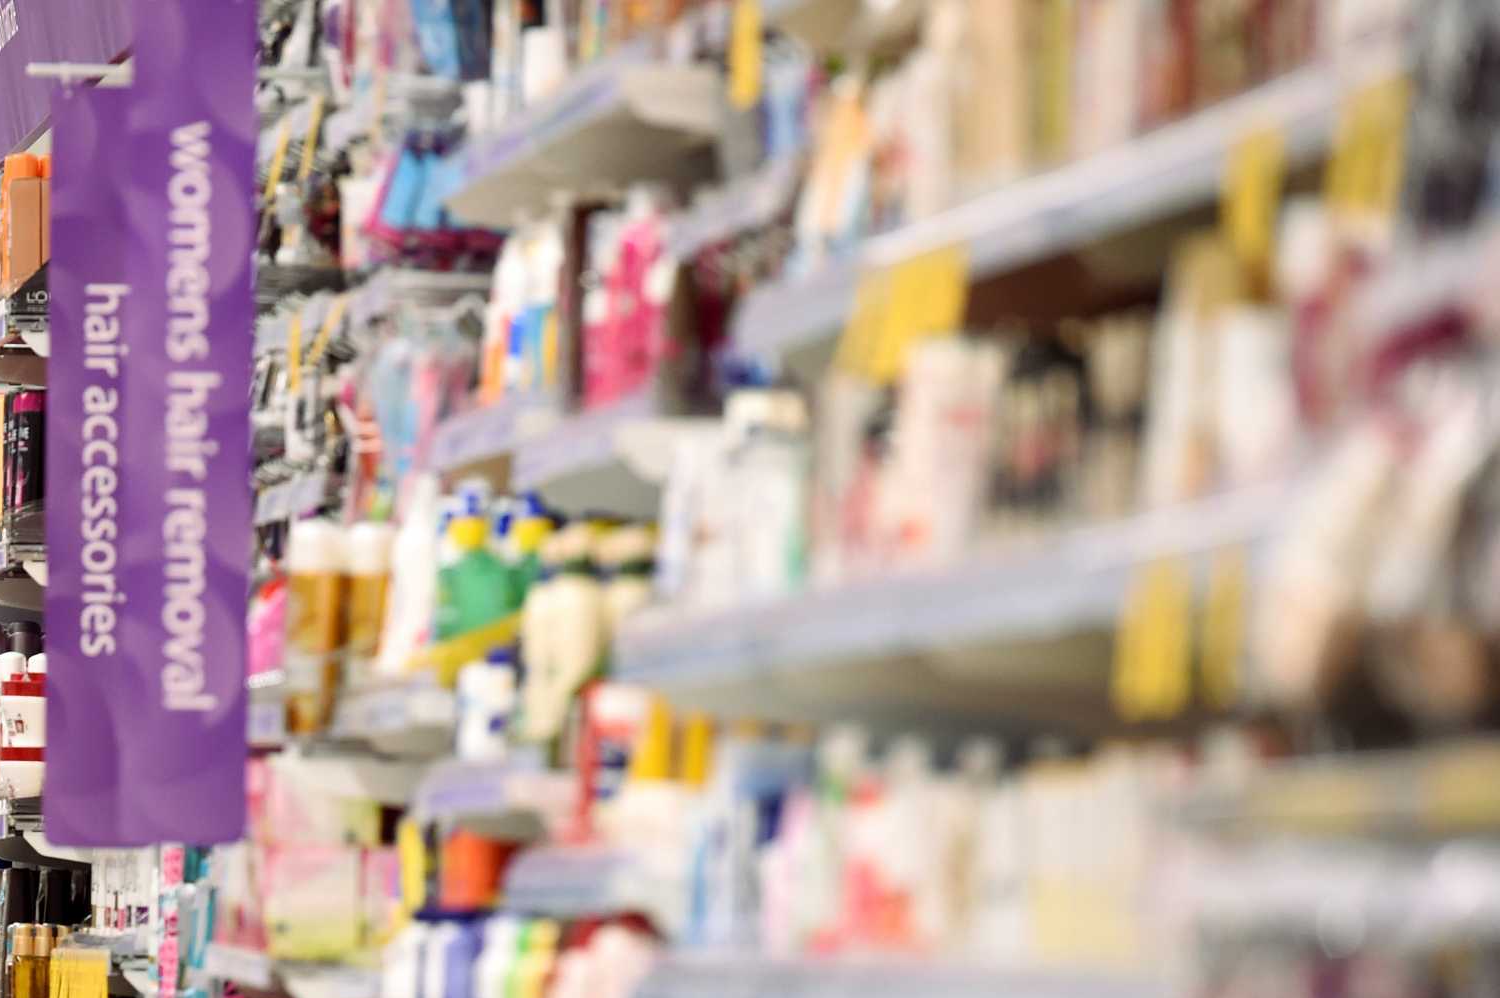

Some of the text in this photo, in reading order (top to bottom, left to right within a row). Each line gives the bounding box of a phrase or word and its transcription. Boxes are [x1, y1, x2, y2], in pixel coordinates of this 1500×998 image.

[81, 283, 131, 656] hair accessories
[162, 120, 222, 712] womens hair removal
